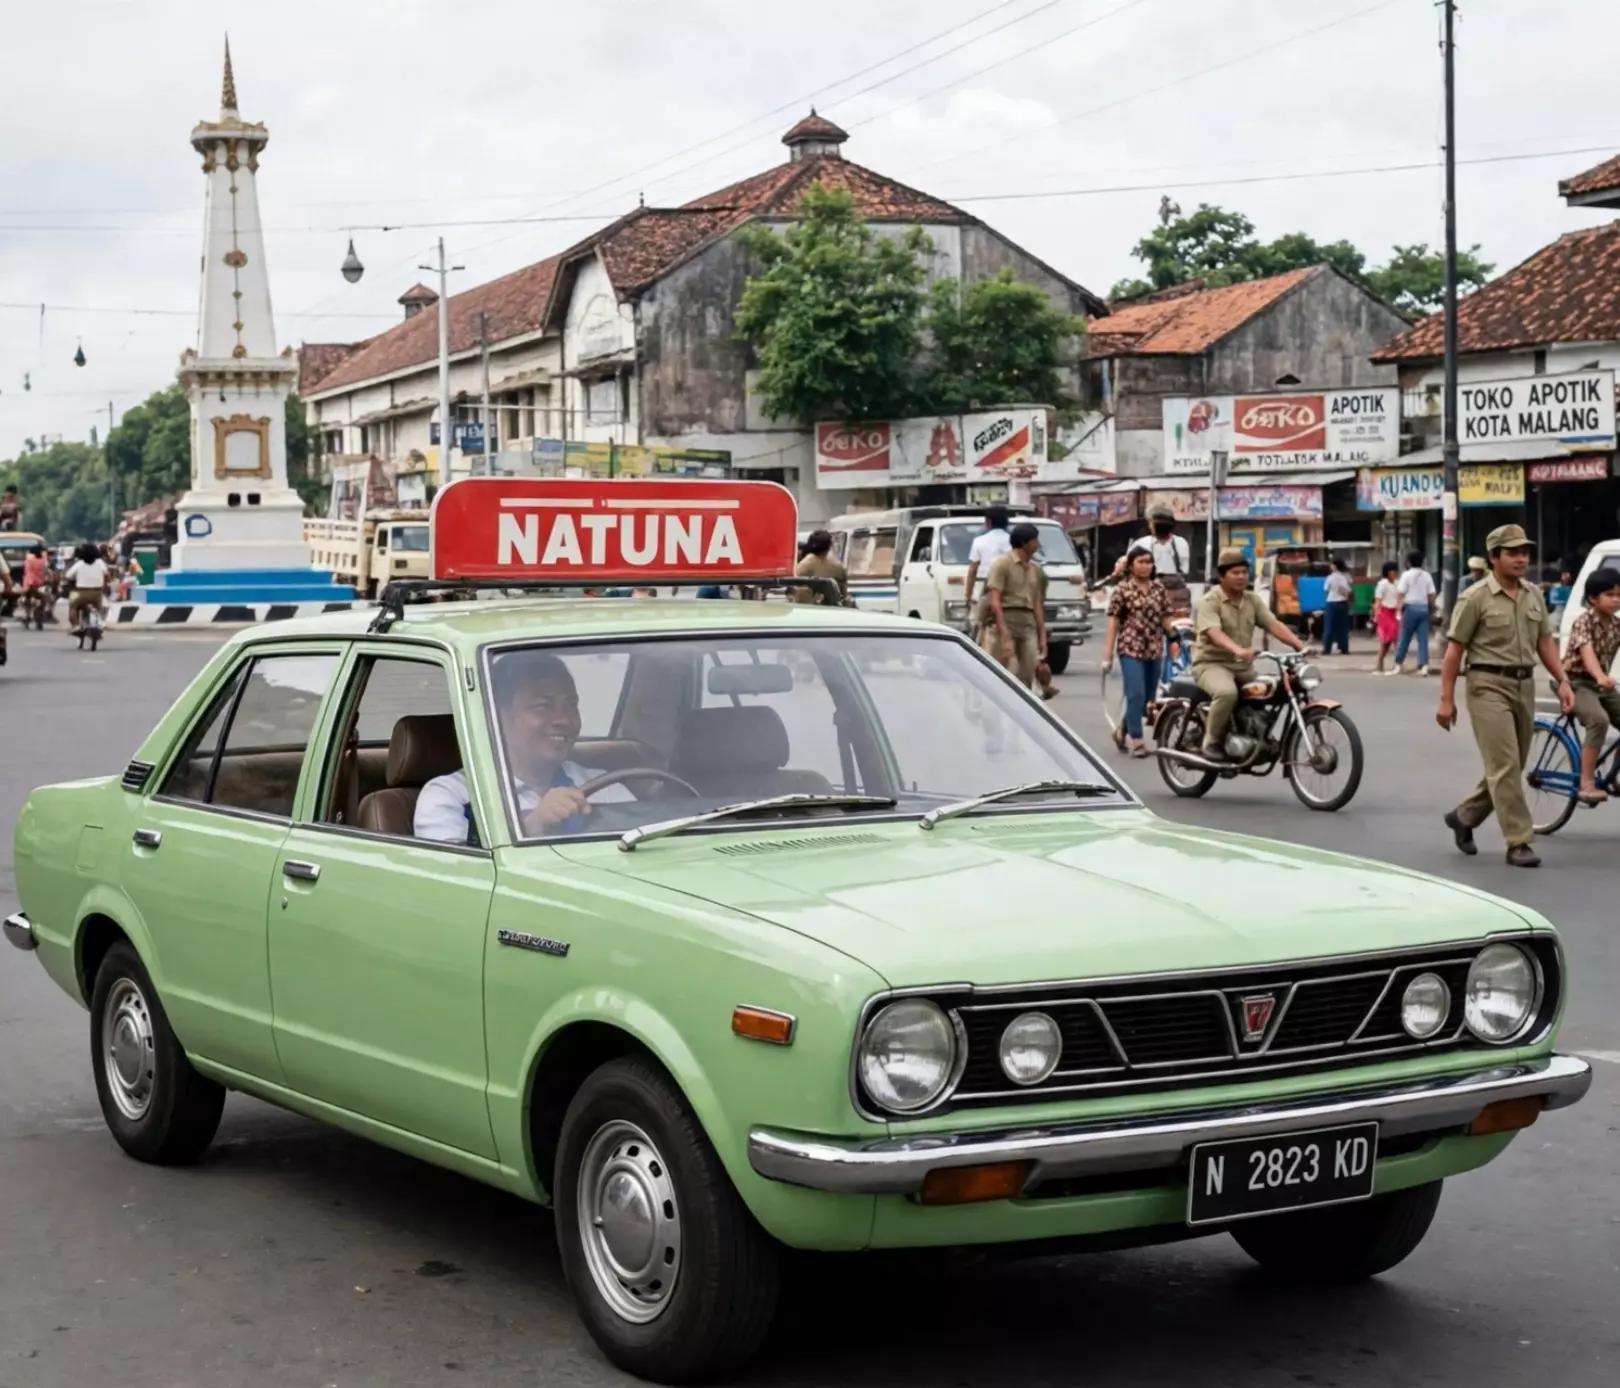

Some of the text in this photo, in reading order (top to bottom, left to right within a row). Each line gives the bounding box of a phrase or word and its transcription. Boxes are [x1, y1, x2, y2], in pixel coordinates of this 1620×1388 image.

[1331, 394, 1384, 415] APOTIK
[1462, 378, 1602, 411] TOKO APOTIK
[1466, 408, 1599, 438] KOTA MALANG
[497, 512, 744, 566] NATUNA
[1206, 1137, 1369, 1196] N 2823 KD
